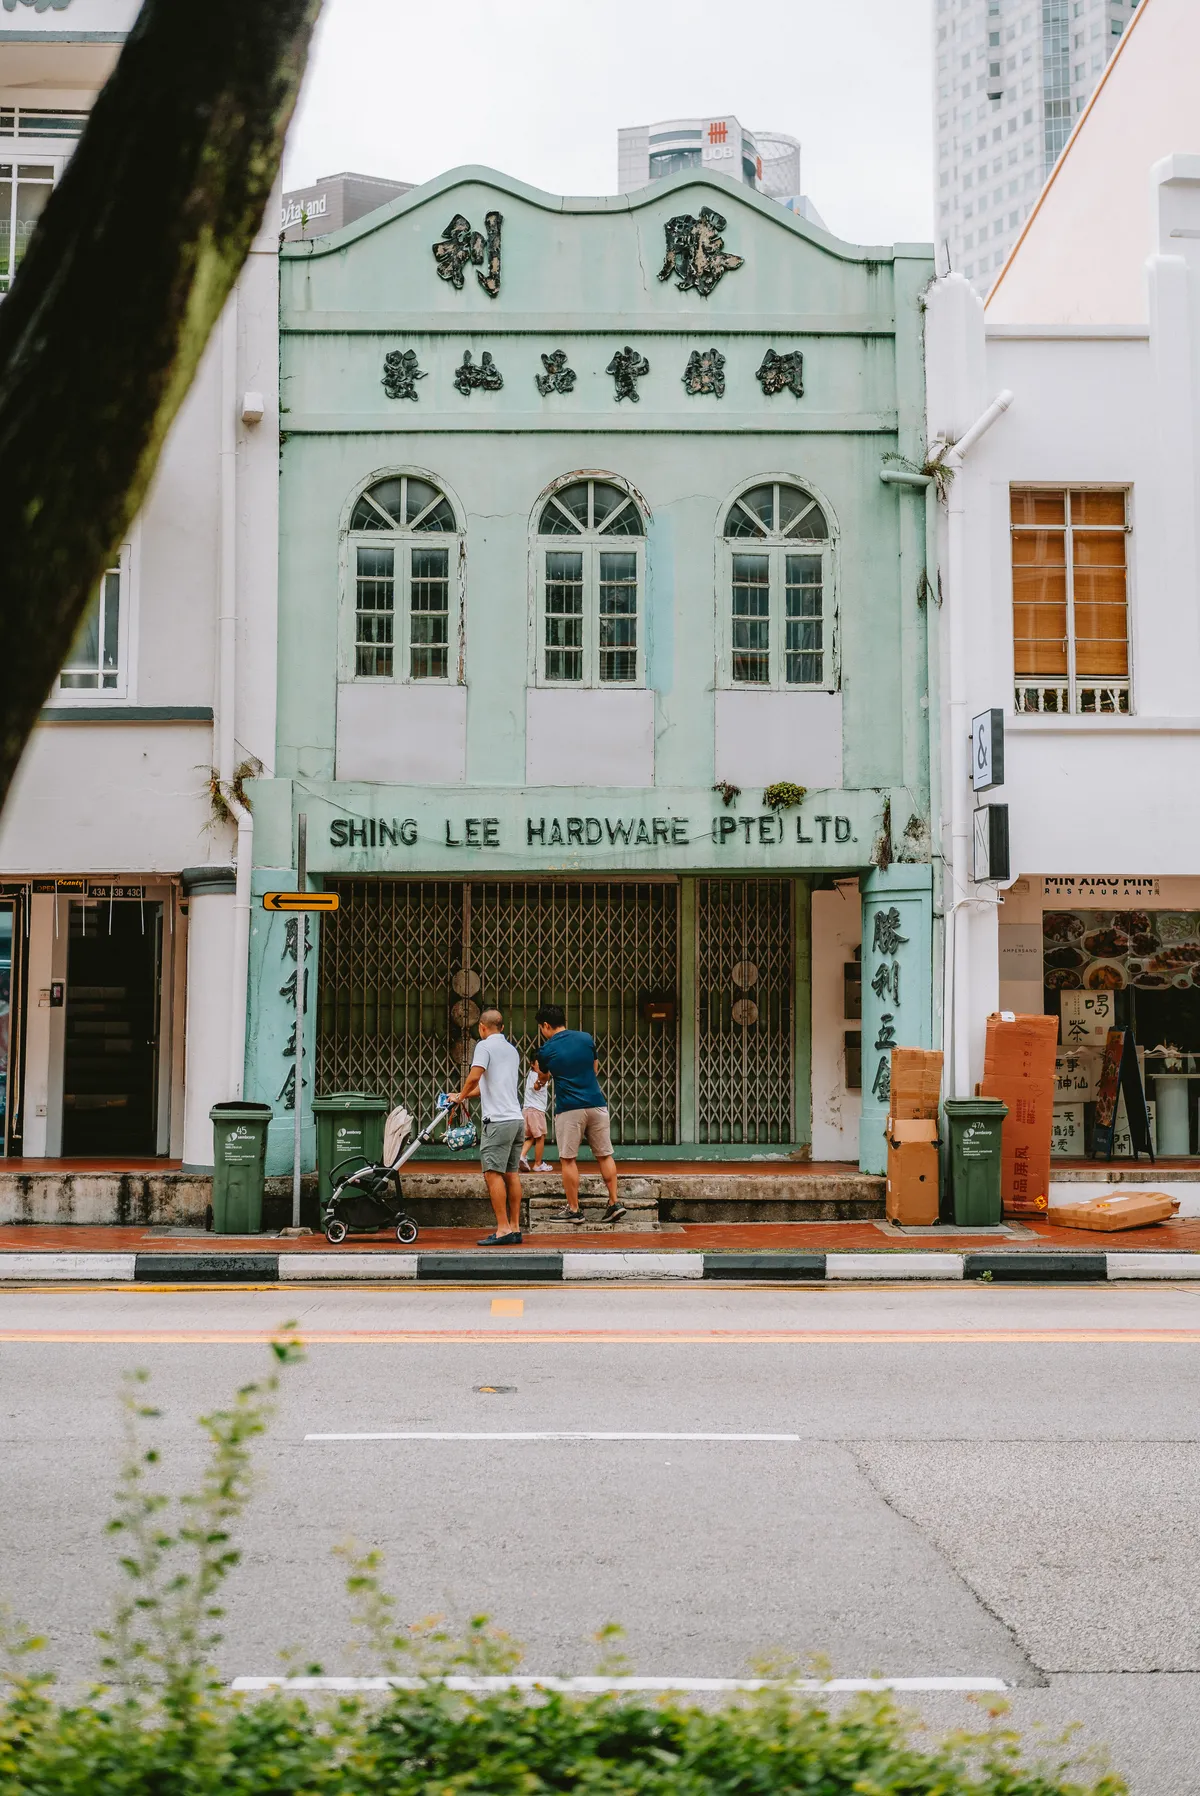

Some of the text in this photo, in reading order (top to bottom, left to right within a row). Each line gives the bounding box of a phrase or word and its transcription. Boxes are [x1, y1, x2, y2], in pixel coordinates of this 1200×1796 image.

[702, 147, 734, 161] UOB
[330, 816, 858, 847] SHING LEE HARDWARE (PTE) LTD.
[92, 888, 106, 897] 43A
[1045, 888, 1153, 896] RESTAURANT
[971, 1121, 985, 1129] 47A
[236, 1126, 248, 1135] 45
